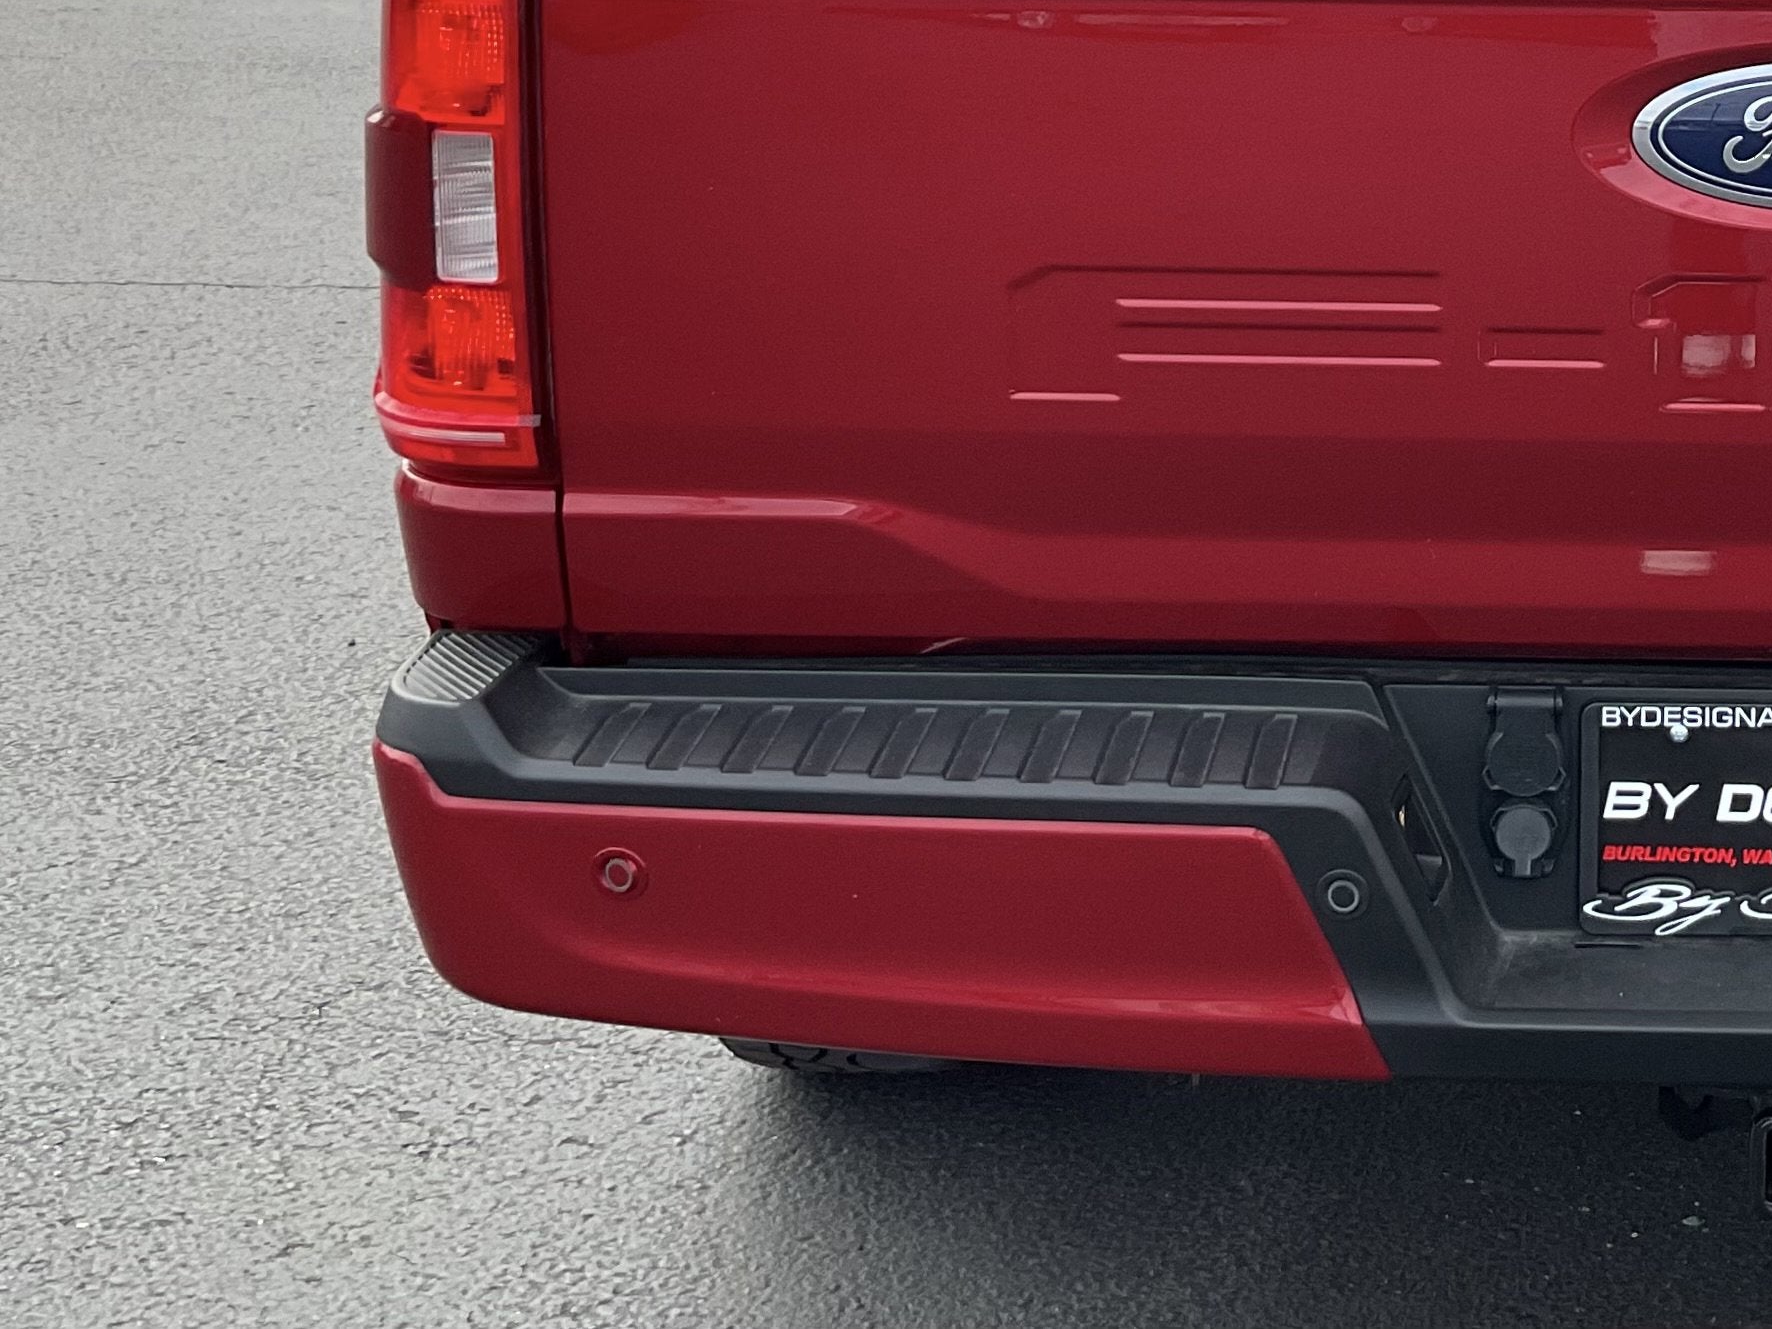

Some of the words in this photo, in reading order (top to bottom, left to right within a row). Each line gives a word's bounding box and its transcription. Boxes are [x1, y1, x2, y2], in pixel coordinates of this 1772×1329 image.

[1603, 781, 1699, 821] BY
[1602, 845, 1737, 868] BURLINGTON,
[1583, 883, 1731, 936] By
